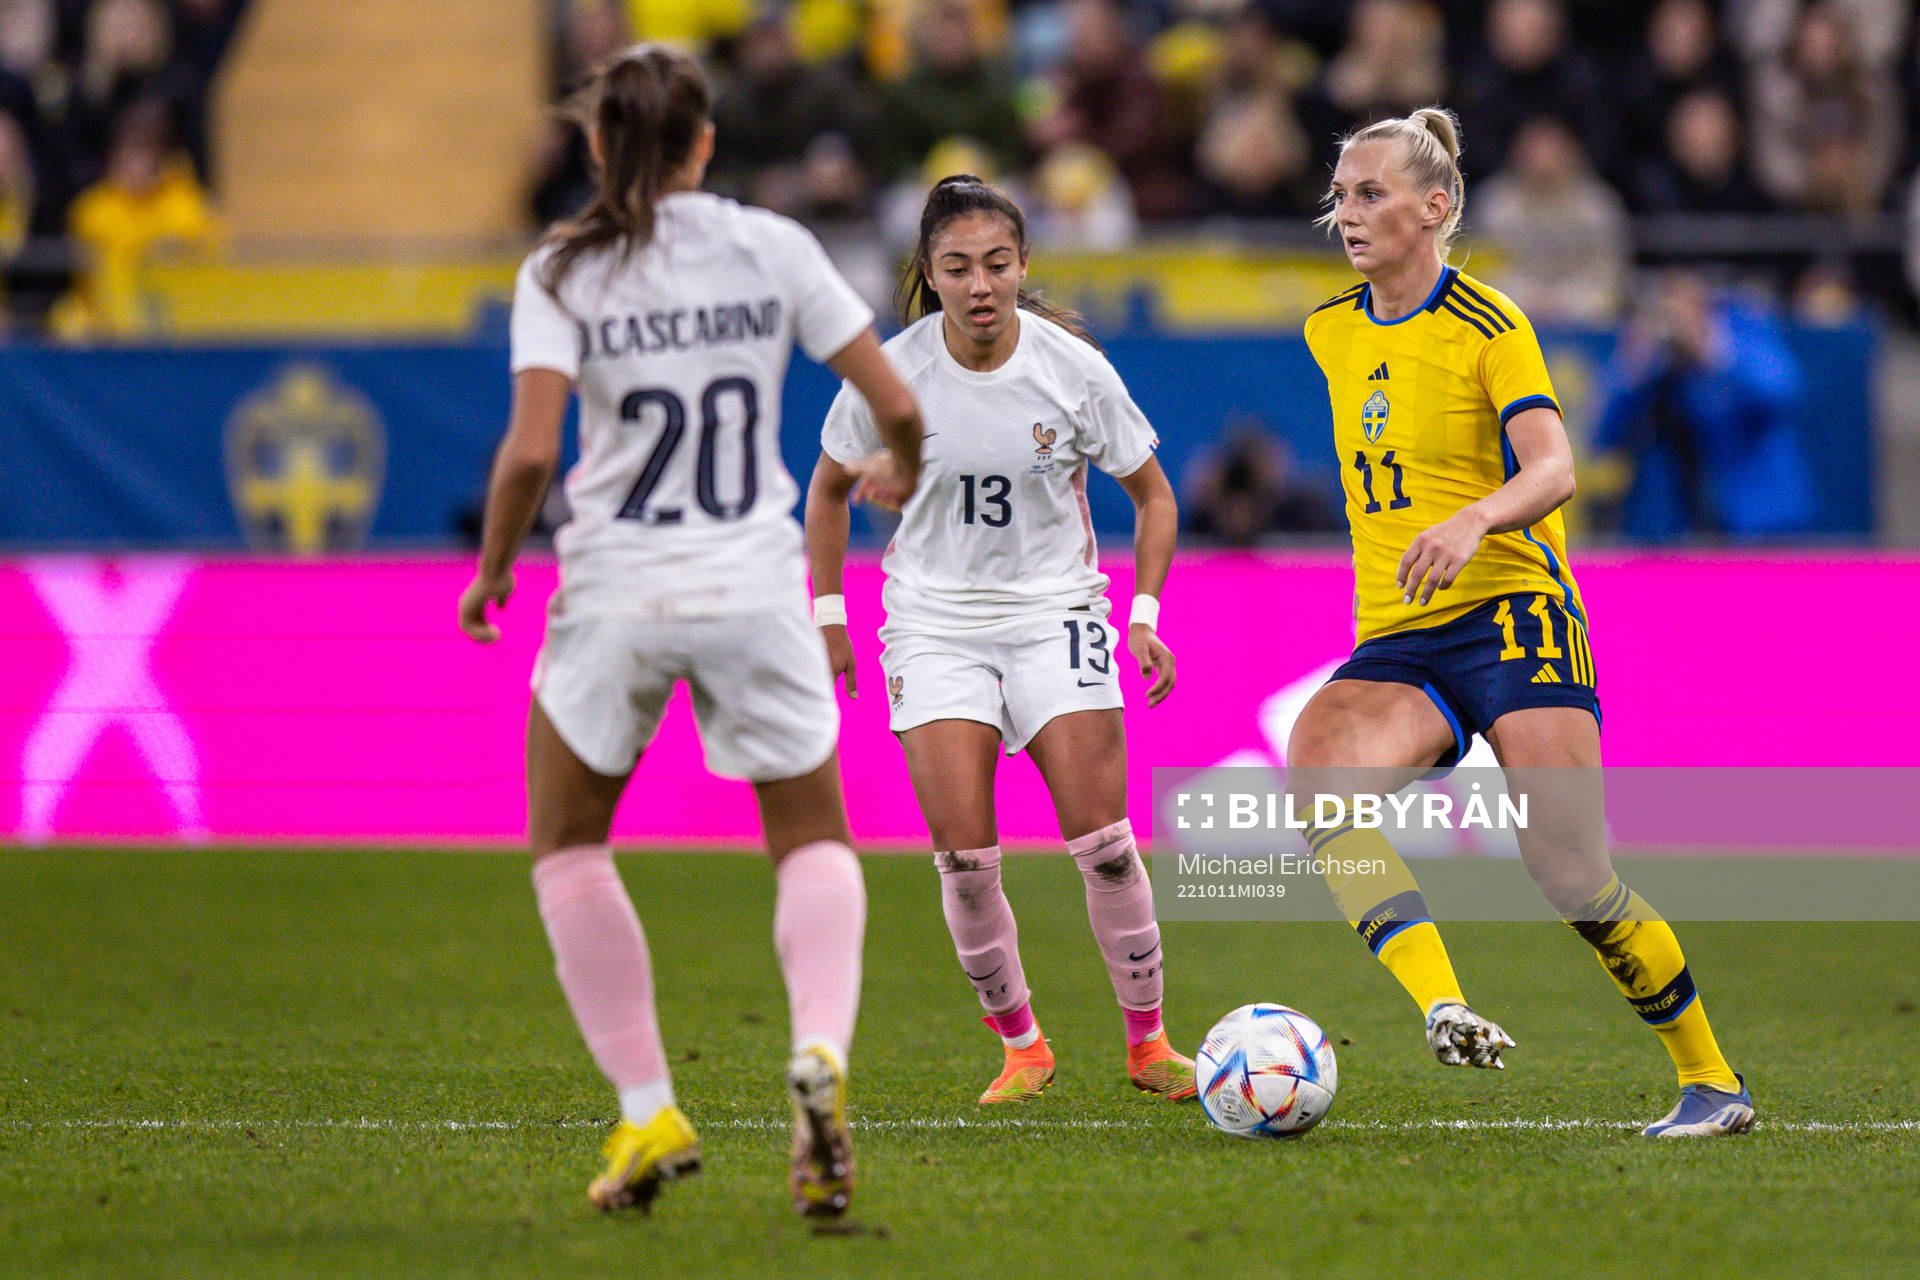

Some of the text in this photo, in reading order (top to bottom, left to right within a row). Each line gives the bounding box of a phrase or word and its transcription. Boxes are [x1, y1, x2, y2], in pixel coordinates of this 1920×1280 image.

[616, 376, 757, 524] 20
[959, 474, 1012, 528] 13
[1354, 450, 1412, 514] 11
[1063, 619, 1110, 674] 13
[1493, 595, 1562, 662] 11
[1362, 907, 1398, 943] ERIGE
